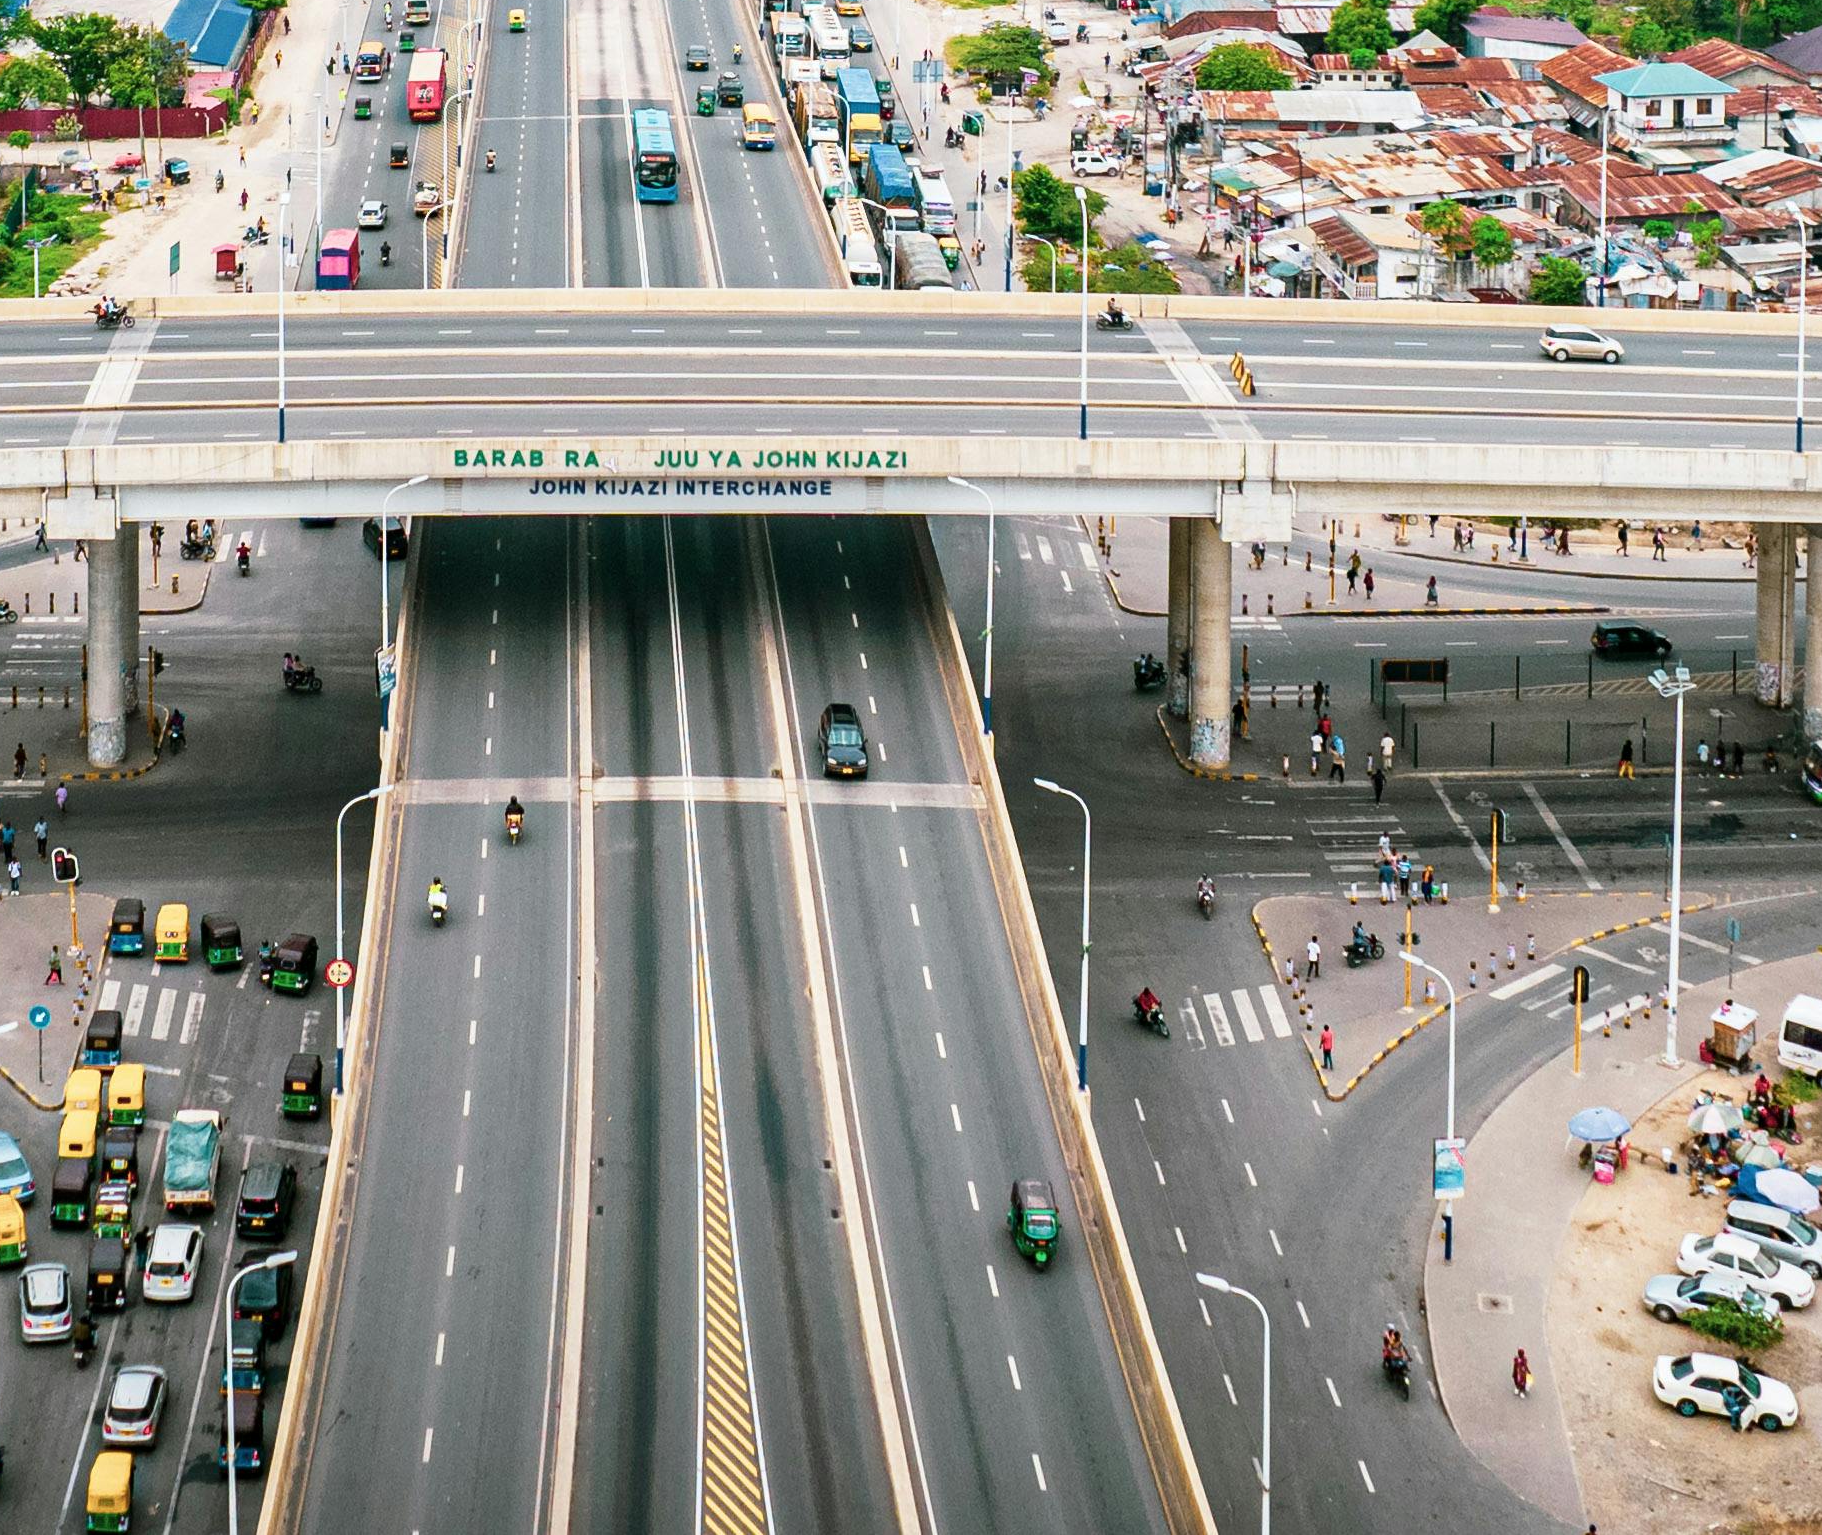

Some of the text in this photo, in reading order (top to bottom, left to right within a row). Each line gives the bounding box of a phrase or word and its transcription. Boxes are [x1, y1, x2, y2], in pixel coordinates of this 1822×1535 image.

[654, 450, 698, 468] JUU
[707, 450, 743, 468] YA
[753, 450, 817, 468] JOHN
[826, 451, 908, 469] KIJAZI
[529, 478, 832, 496] JOHN KIJAZI INTERCHANGE
